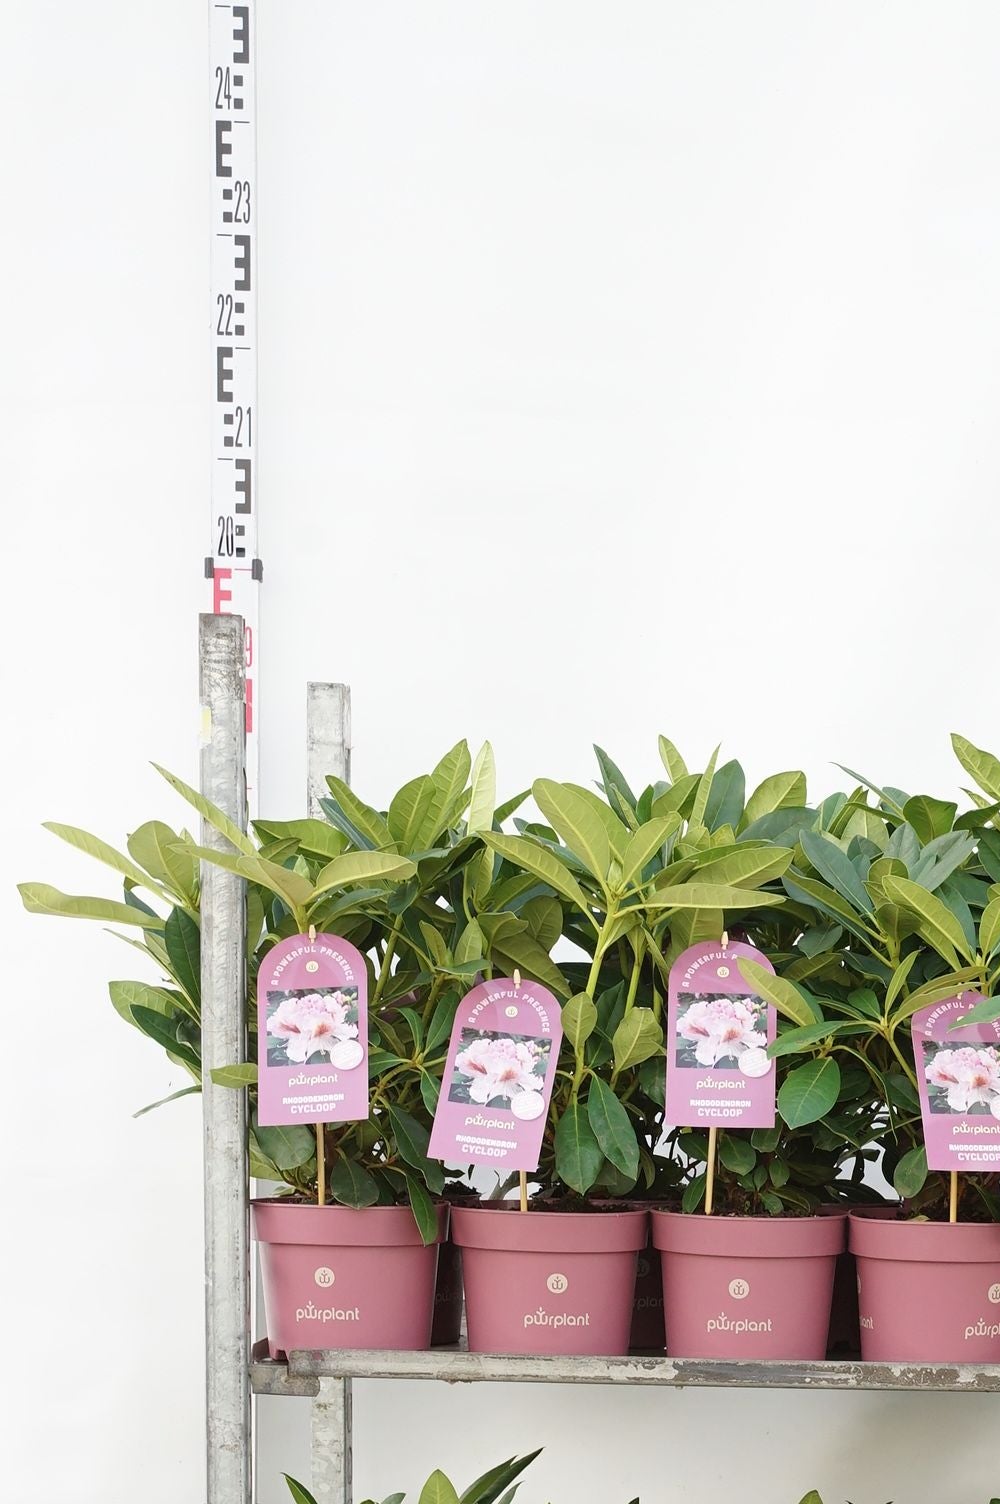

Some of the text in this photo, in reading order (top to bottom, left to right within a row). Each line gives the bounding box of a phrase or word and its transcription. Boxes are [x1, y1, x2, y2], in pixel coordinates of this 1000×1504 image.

[216, 67, 232, 110] 24
[234, 180, 250, 224] 23
[217, 293, 233, 336] 22
[235, 405, 252, 448] 21
[218, 515, 234, 557] 20
[274, 945, 317, 979] POWERFUL
[320, 945, 354, 981] PRESENCE
[684, 952, 728, 980] POWERFUL
[474, 991, 519, 1017] POWERFUL
[521, 993, 551, 1034] PRESENCE
[926, 1001, 966, 1028] POWERFUL
[290, 1102, 337, 1115] CYCLOOP
[697, 1108, 744, 1119] CYCLOOP
[461, 1143, 508, 1159] CYCLOOP
